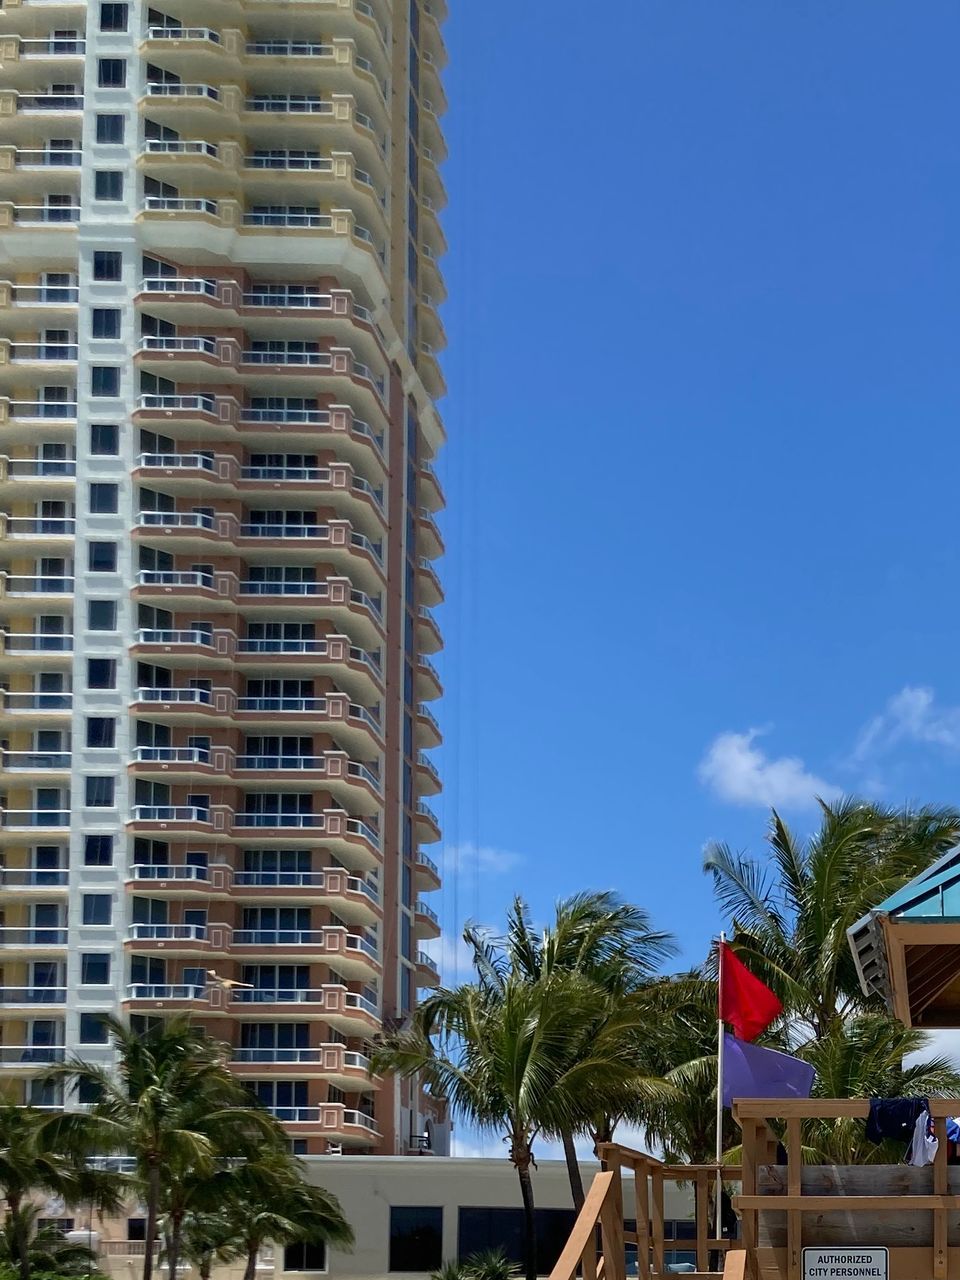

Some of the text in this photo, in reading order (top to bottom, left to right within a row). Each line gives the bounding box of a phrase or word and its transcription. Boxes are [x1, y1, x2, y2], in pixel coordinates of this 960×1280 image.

[817, 1255, 873, 1264] AUTHORIZED
[808, 1268, 882, 1277] CITY PERSONNEL
